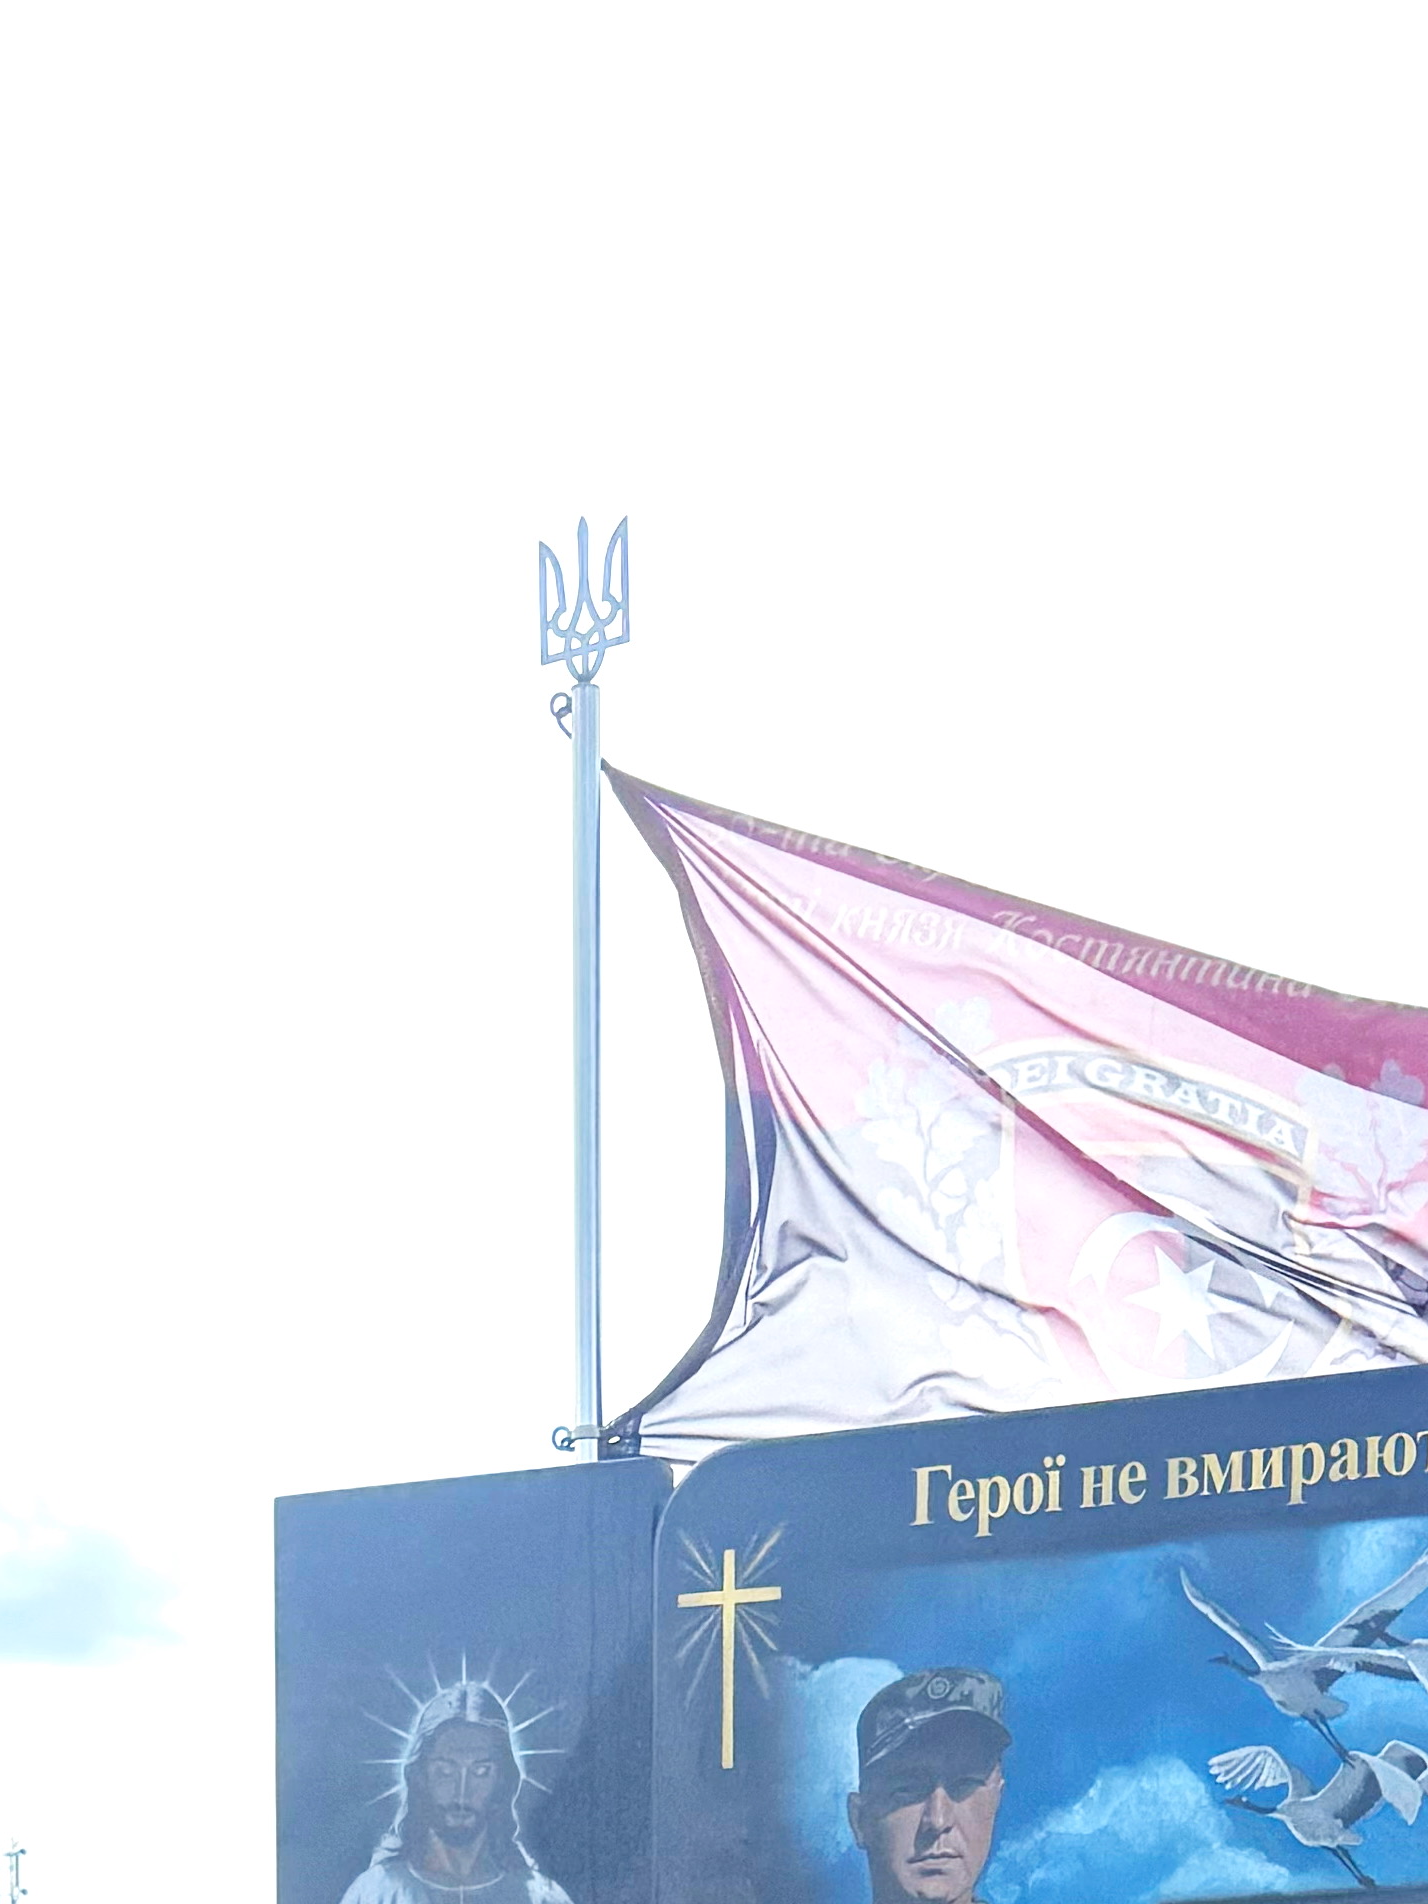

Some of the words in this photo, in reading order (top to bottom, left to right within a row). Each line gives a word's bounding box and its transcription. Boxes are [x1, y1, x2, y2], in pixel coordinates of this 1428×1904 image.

[1084, 1053, 1300, 1157] GRATIA
[910, 1453, 1067, 1538] Герої
[1080, 1459, 1147, 1509] не
